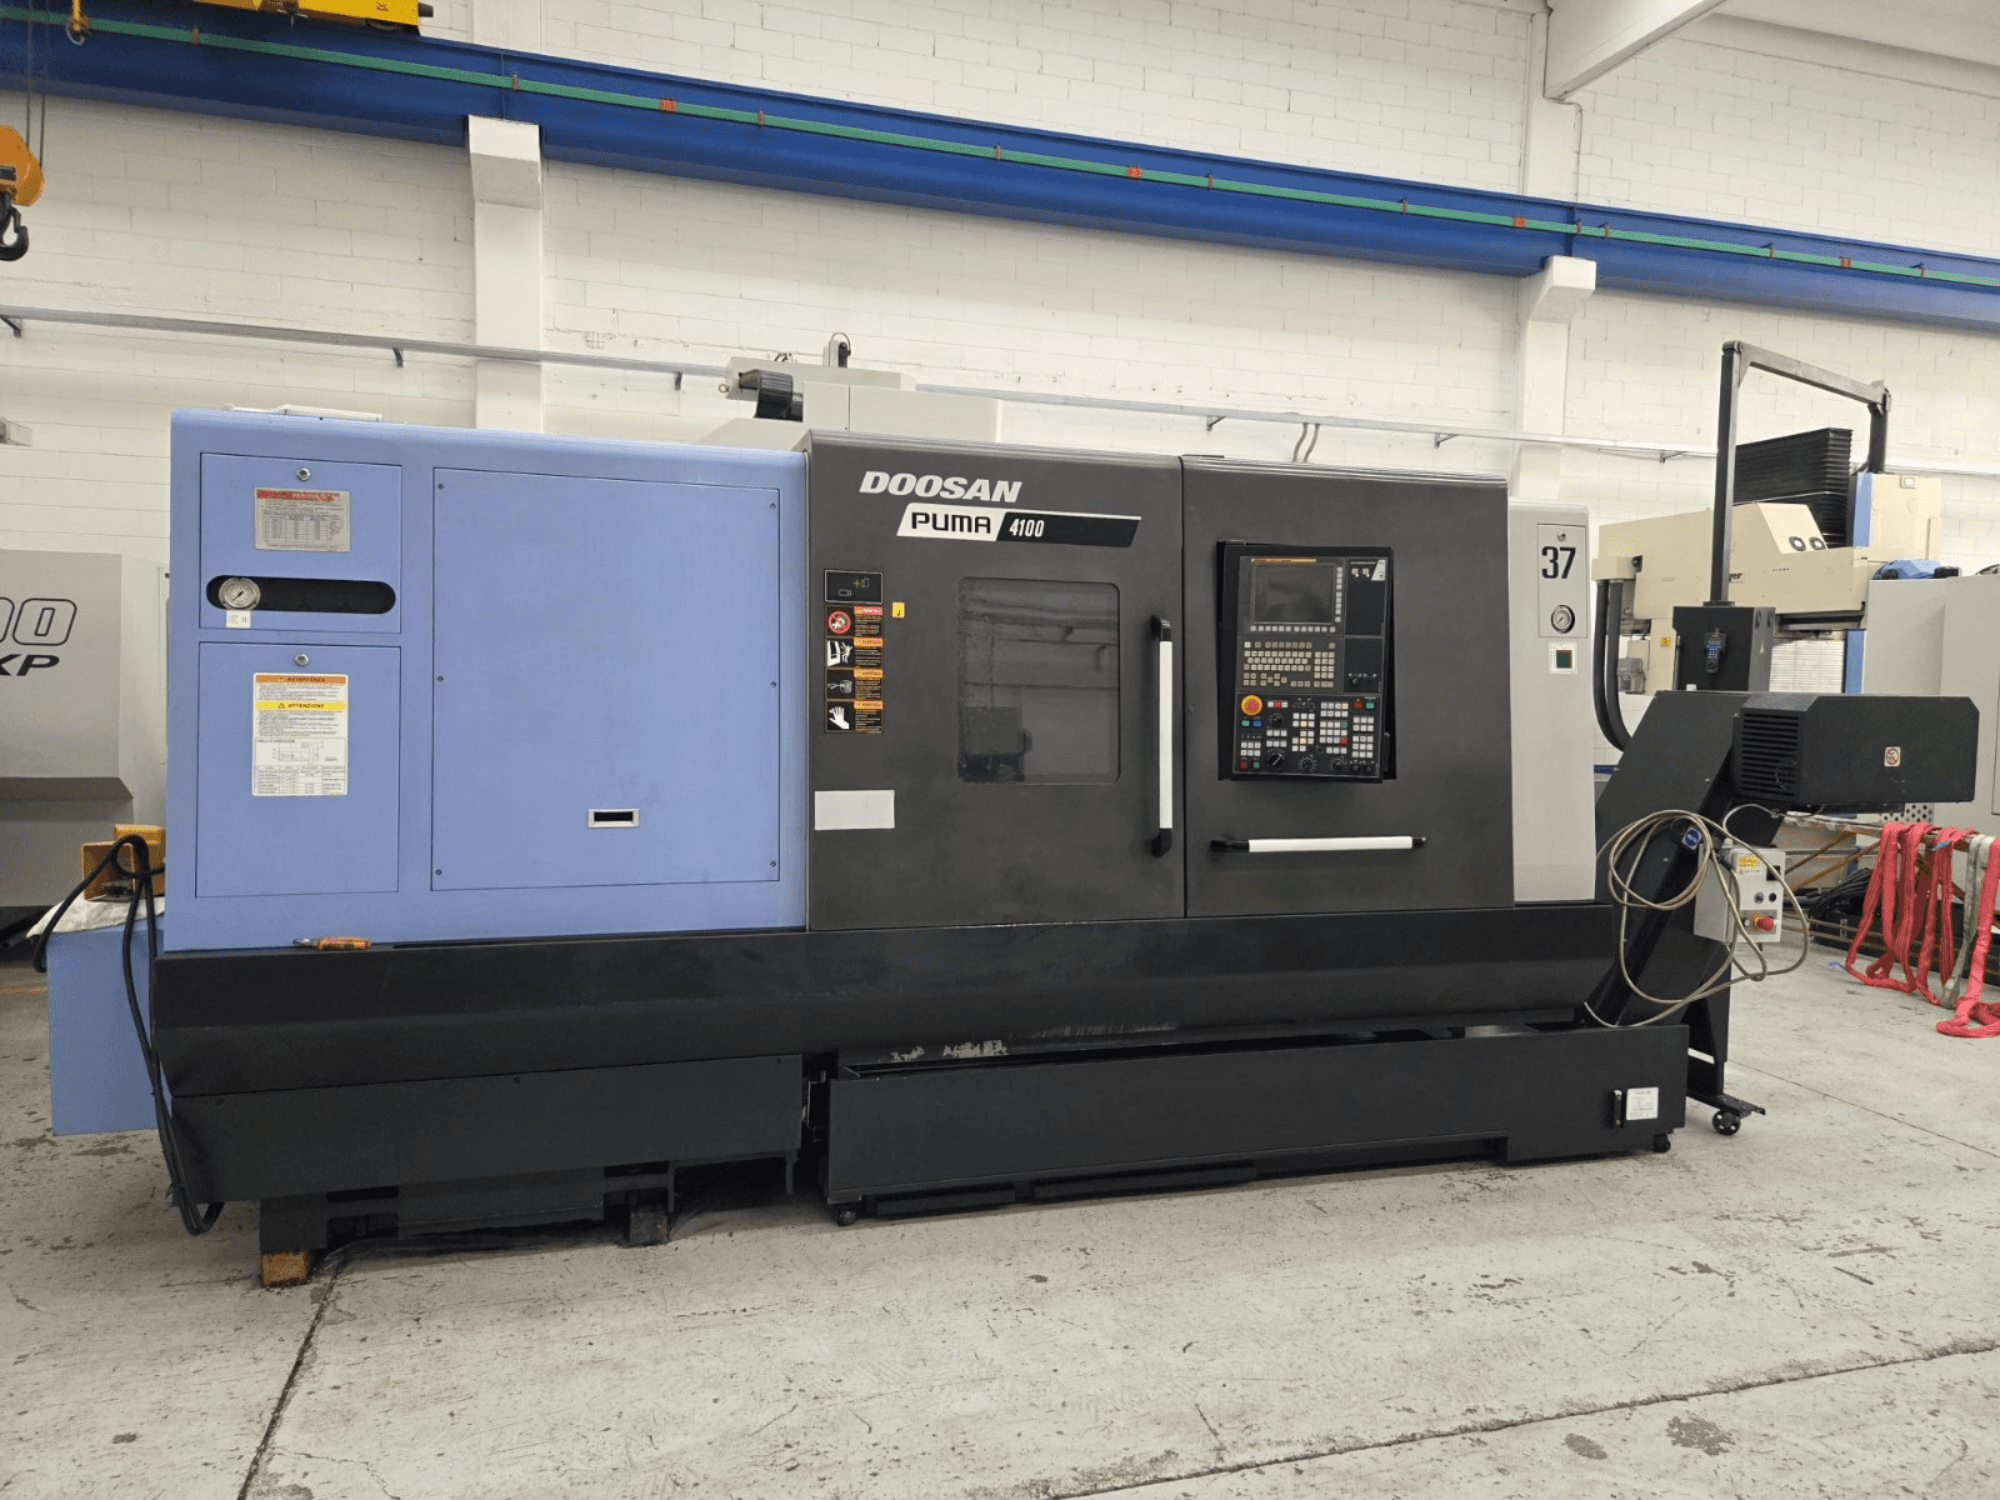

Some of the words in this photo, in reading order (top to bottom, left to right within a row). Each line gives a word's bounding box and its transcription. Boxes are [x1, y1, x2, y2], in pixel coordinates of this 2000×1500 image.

[859, 470, 1022, 503] DOOSAN
[911, 511, 991, 534] PUMA
[1009, 518, 1045, 538] 4100
[1541, 546, 1577, 580] 37
[0, 597, 77, 646] 0
